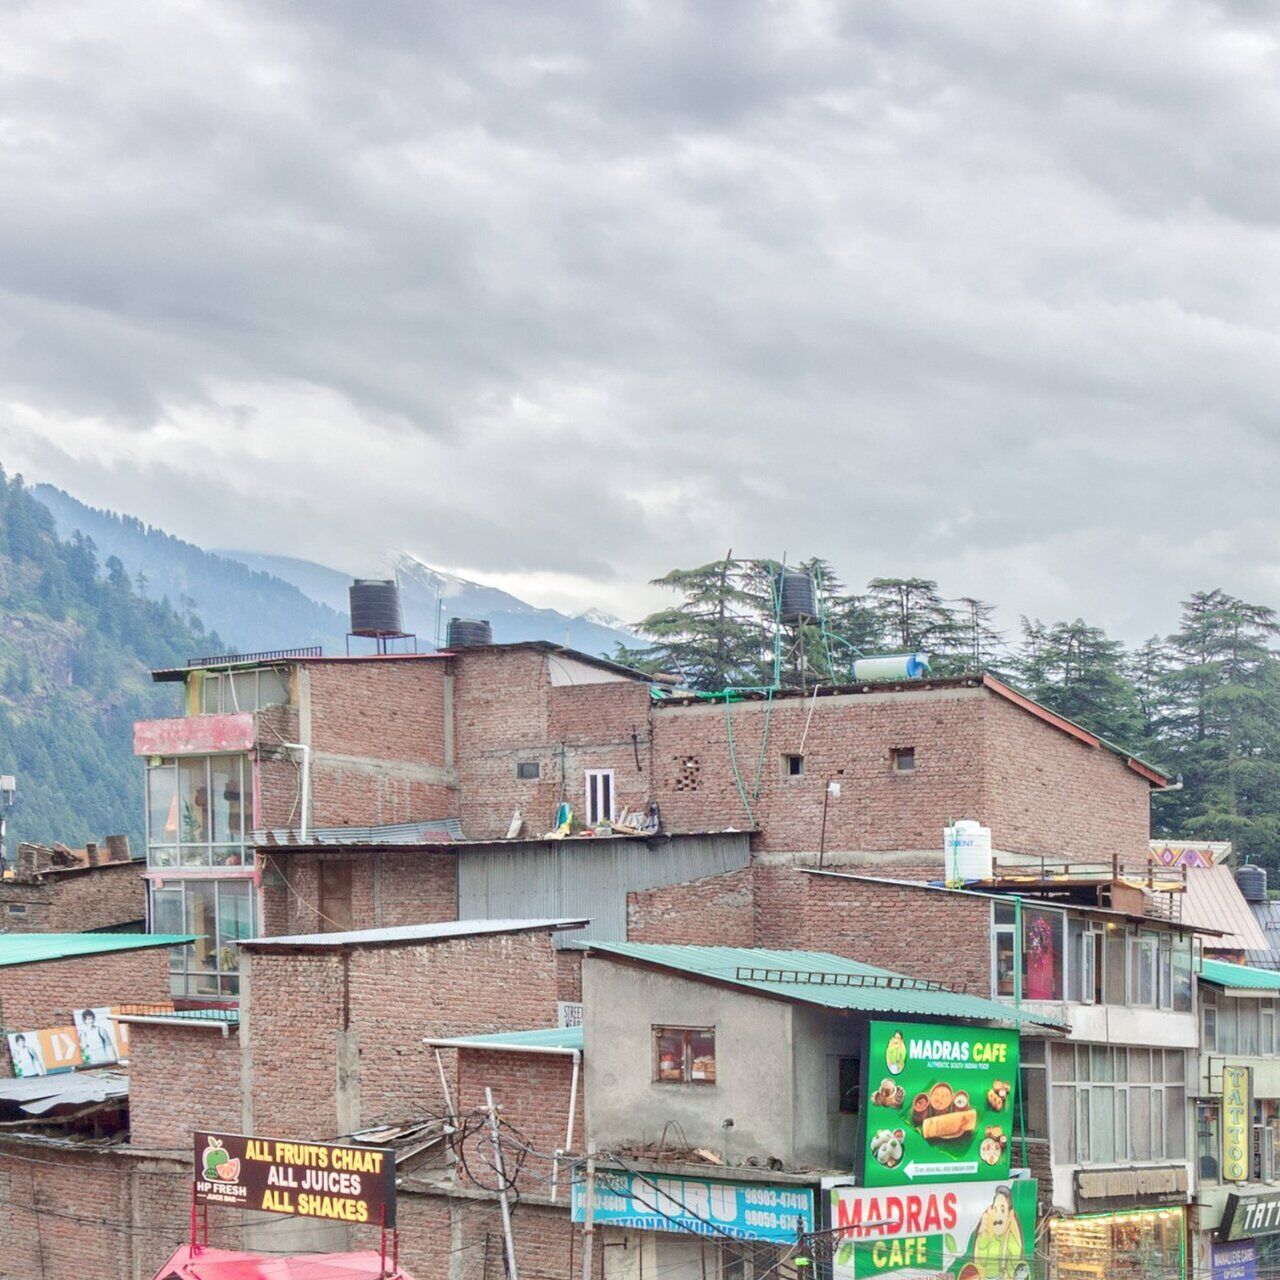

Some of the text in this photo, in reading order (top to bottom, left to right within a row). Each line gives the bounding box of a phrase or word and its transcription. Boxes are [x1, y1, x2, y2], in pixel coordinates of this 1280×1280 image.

[909, 1039, 1007, 1062] MADRAS CAFE
[1228, 1071, 1244, 1178] TATTOO
[245, 1140, 384, 1173] ALL FRUITS CHAAT
[196, 1182, 247, 1196] HP FRESH
[267, 1166, 362, 1195] ALL JUICES
[261, 1190, 368, 1222] ALL SHAKES
[631, 1176, 738, 1222] GURU
[837, 1192, 958, 1238] MADRAS
[872, 1237, 927, 1268] CAFE
